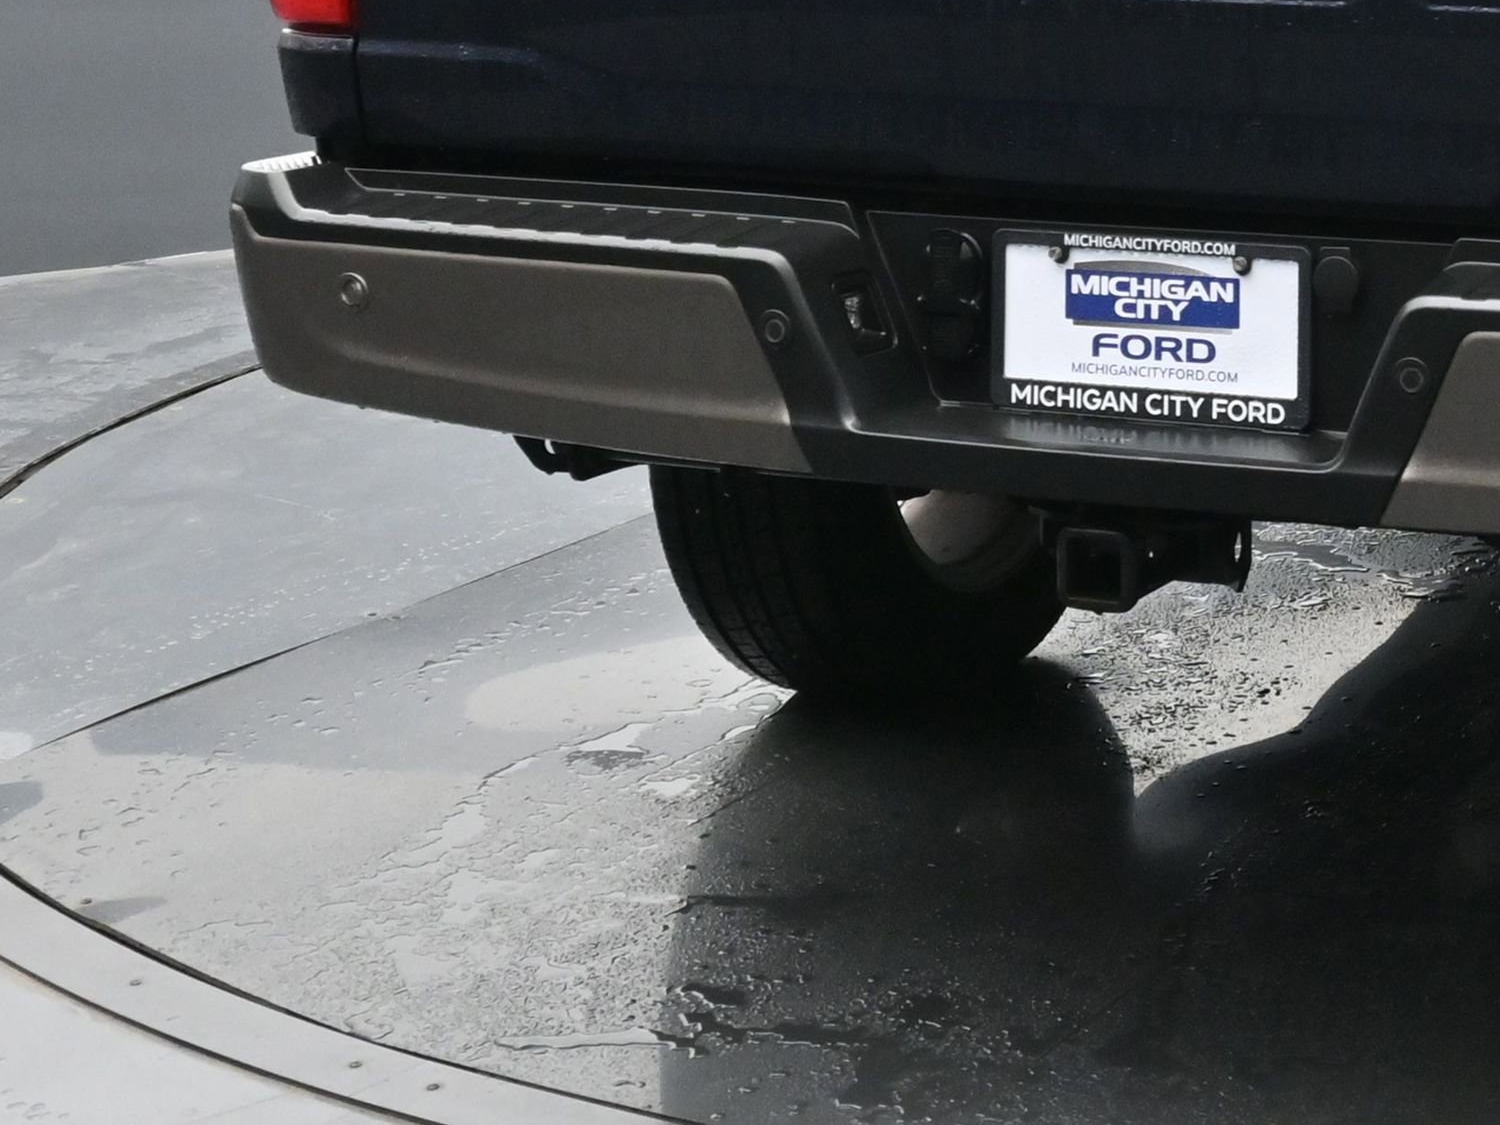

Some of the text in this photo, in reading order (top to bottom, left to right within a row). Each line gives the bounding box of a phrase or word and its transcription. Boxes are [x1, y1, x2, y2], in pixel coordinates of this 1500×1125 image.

[1063, 233, 1236, 256] MICHIGANCITYFORD.COM
[1071, 274, 1234, 303] MICHIGAN
[1114, 298, 1190, 321] CITY
[1092, 333, 1216, 363] FORD
[1071, 362, 1239, 383] MICHIGANCITYFORD.COM
[1010, 383, 1285, 425] MICHIGAN CITY FORD
